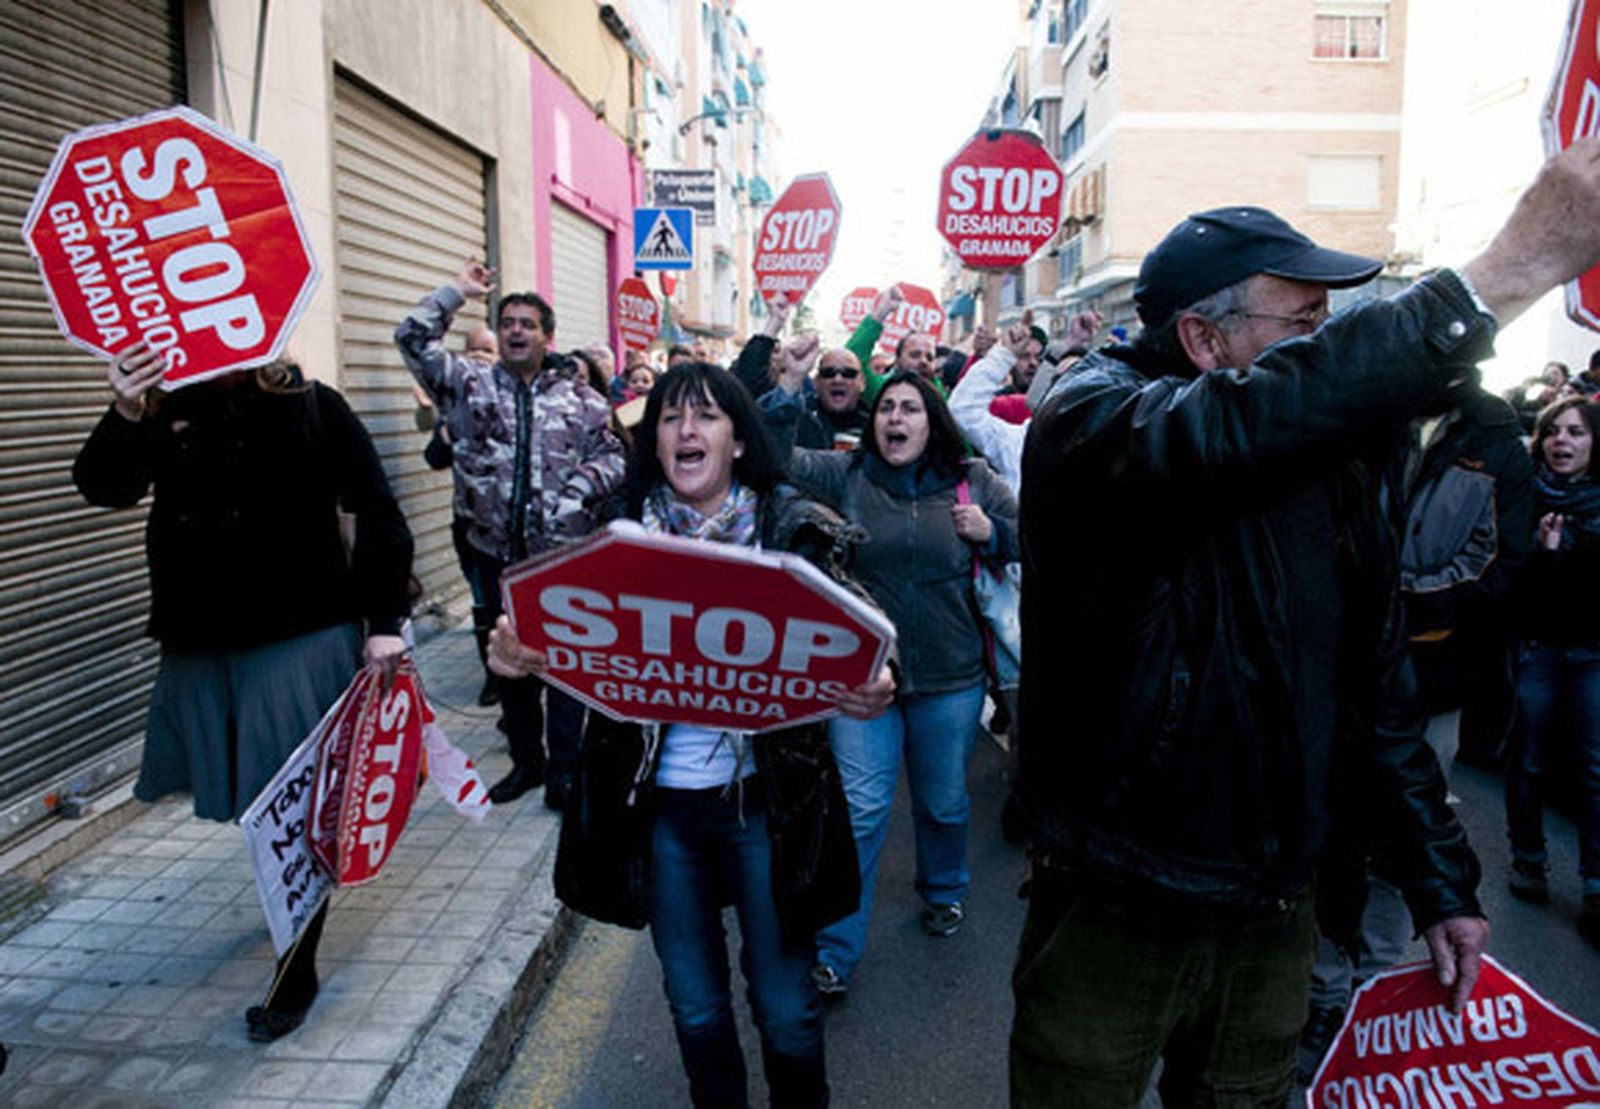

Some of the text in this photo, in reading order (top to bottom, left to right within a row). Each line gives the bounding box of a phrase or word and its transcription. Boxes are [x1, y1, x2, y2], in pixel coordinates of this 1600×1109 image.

[948, 165, 1059, 213] STOP
[120, 137, 266, 350] STOP
[762, 207, 834, 250] STOP
[945, 214, 1054, 236] DESAHUCIOS
[959, 239, 1031, 257] GRANADA
[49, 201, 129, 348] GRANADA
[73, 155, 188, 372] DESAHUCIOS
[757, 253, 826, 272] DESAHUCIOS
[618, 293, 656, 320] STOP
[886, 301, 942, 331] TOP
[538, 584, 861, 674] STOP
[546, 645, 849, 702] DESAHUCIOS
[594, 680, 787, 719] GRANADA
[359, 689, 410, 868] STOP
[1354, 993, 1528, 1058] GRANADA
